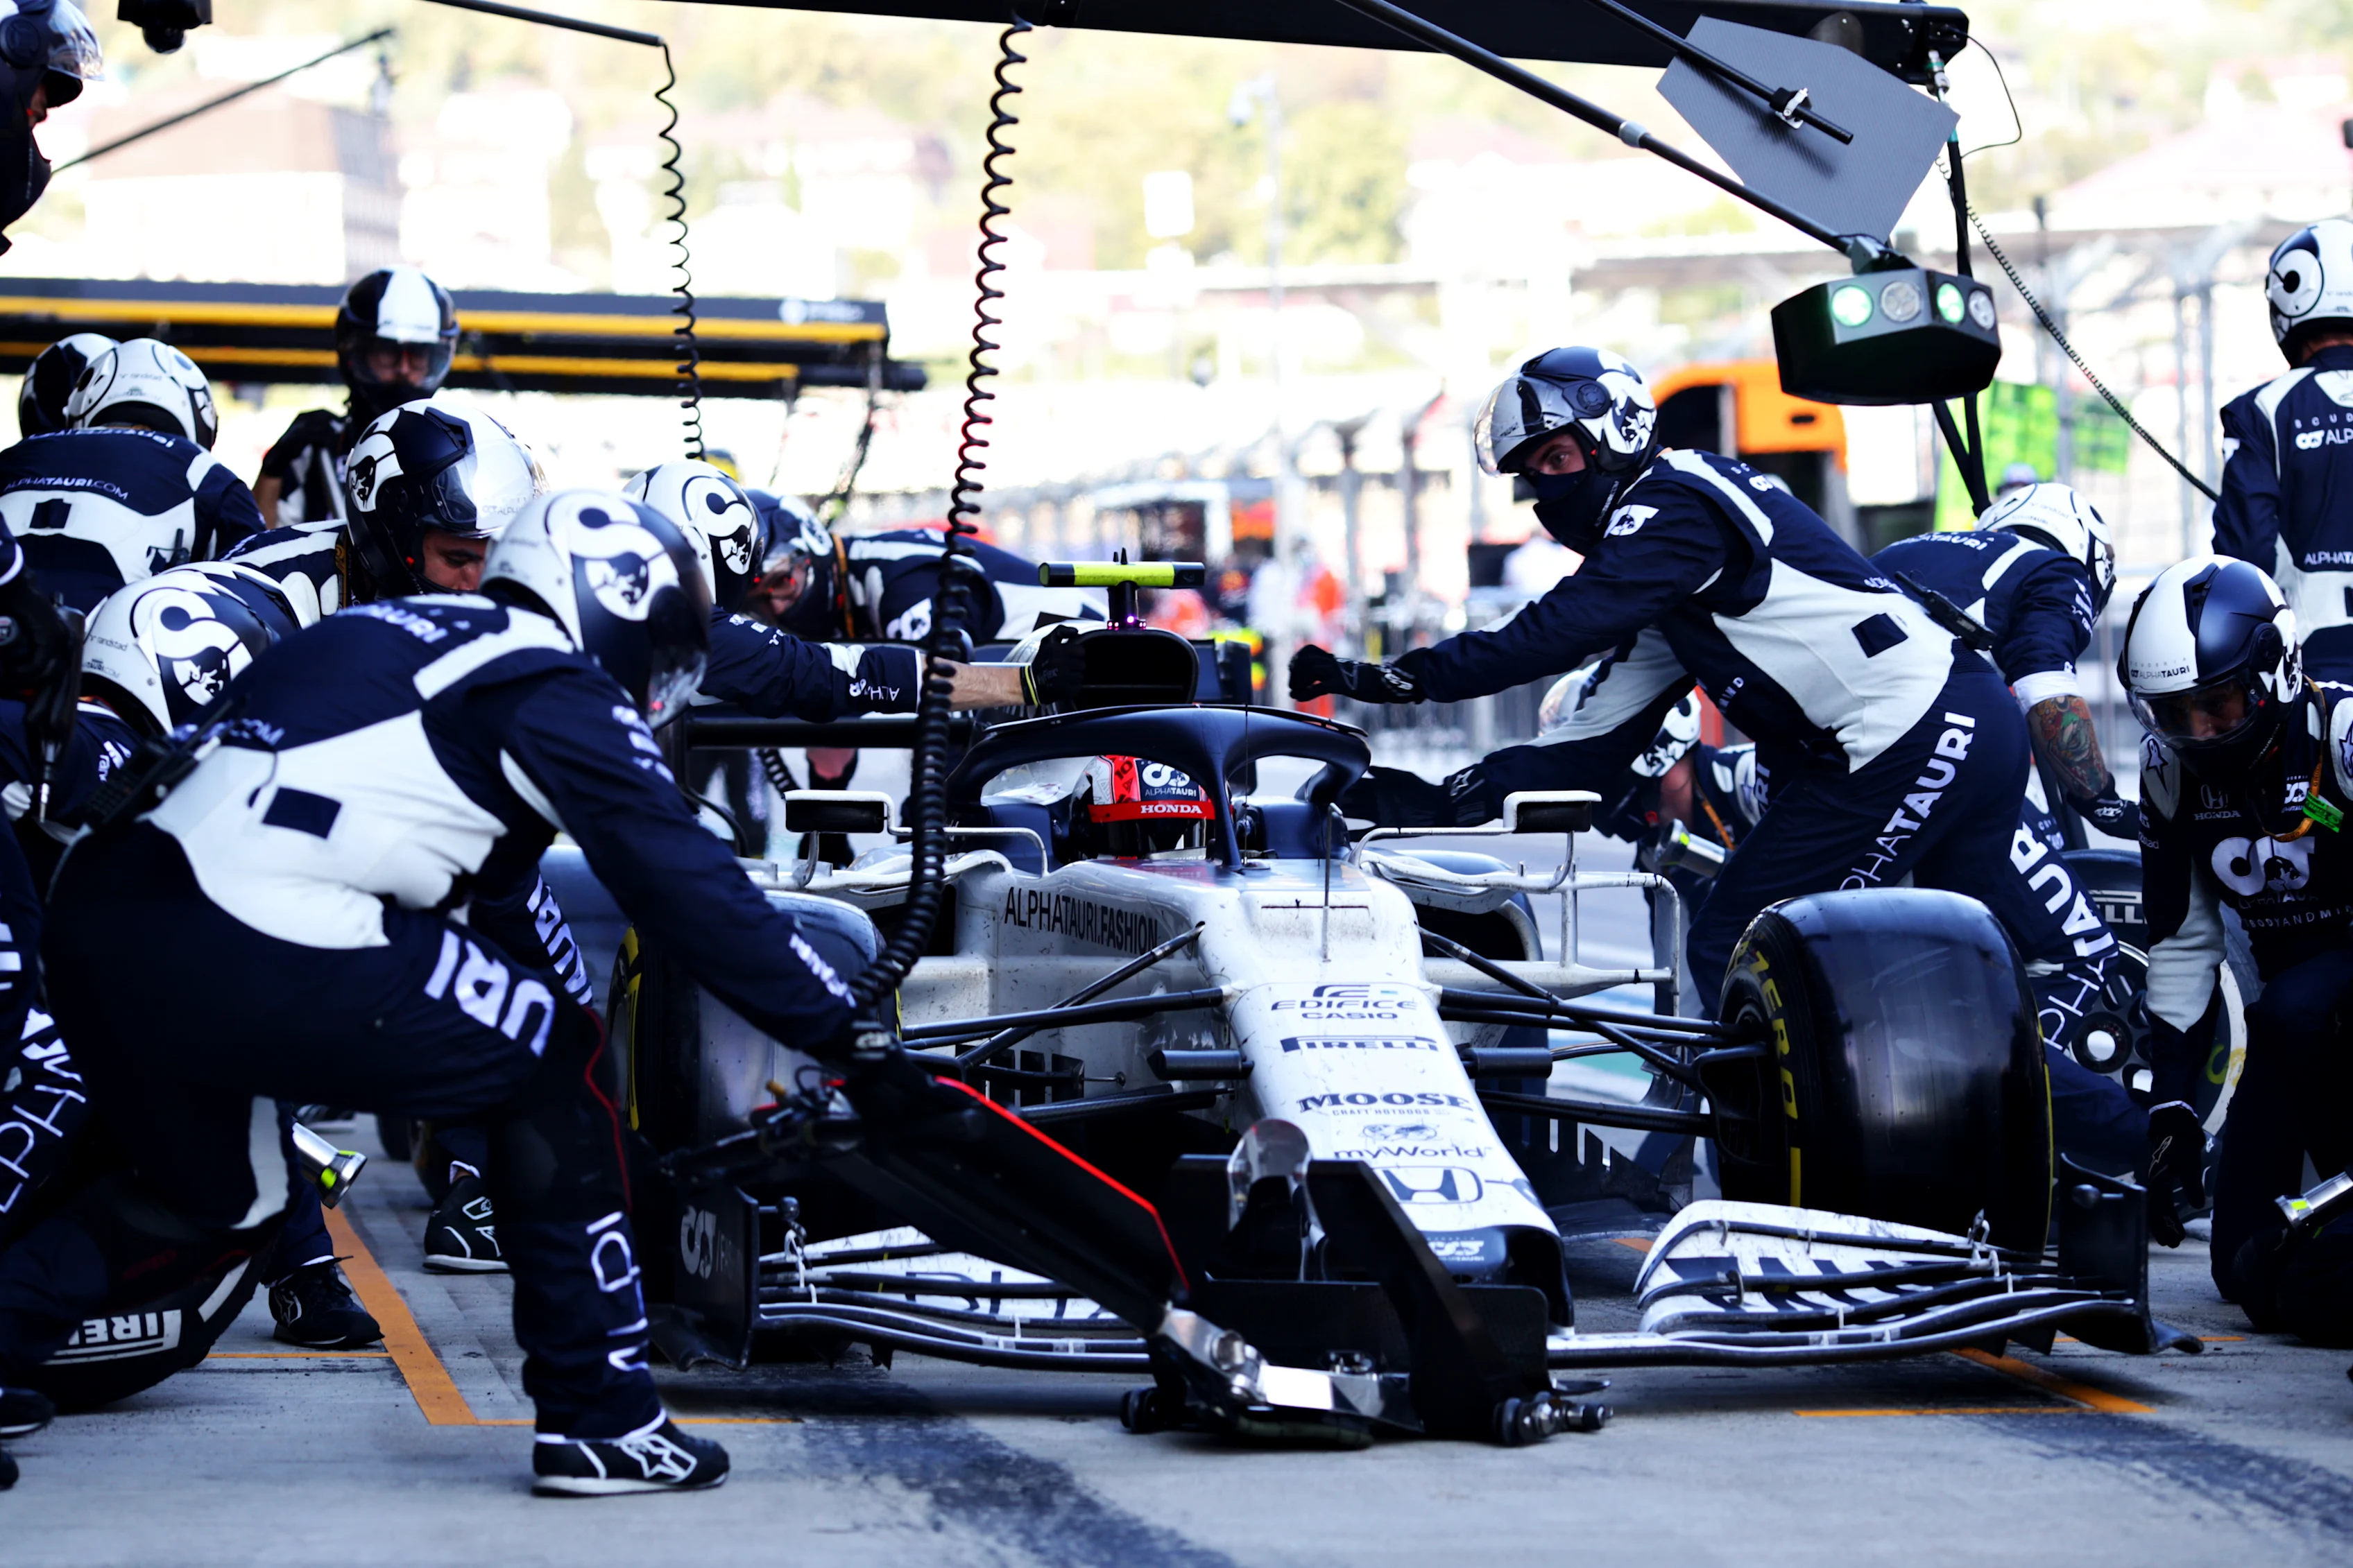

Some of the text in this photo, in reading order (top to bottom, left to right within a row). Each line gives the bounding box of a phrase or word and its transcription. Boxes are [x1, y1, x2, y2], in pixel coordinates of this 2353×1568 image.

[2139, 665, 2191, 679] ALPHATAURI
[1145, 786, 1197, 798] ALPHATAURI
[1140, 804, 1204, 814] HONDA
[2193, 810, 2241, 821] HONDA
[1004, 886, 1158, 957] ALPHATAURI.FASHION
[1271, 1000, 1418, 1011] EDIFICE
[1280, 1035, 1439, 1053] PIRELLI
[1297, 1093, 1474, 1113] MOOSE
[1333, 1146, 1485, 1160] myWorld
